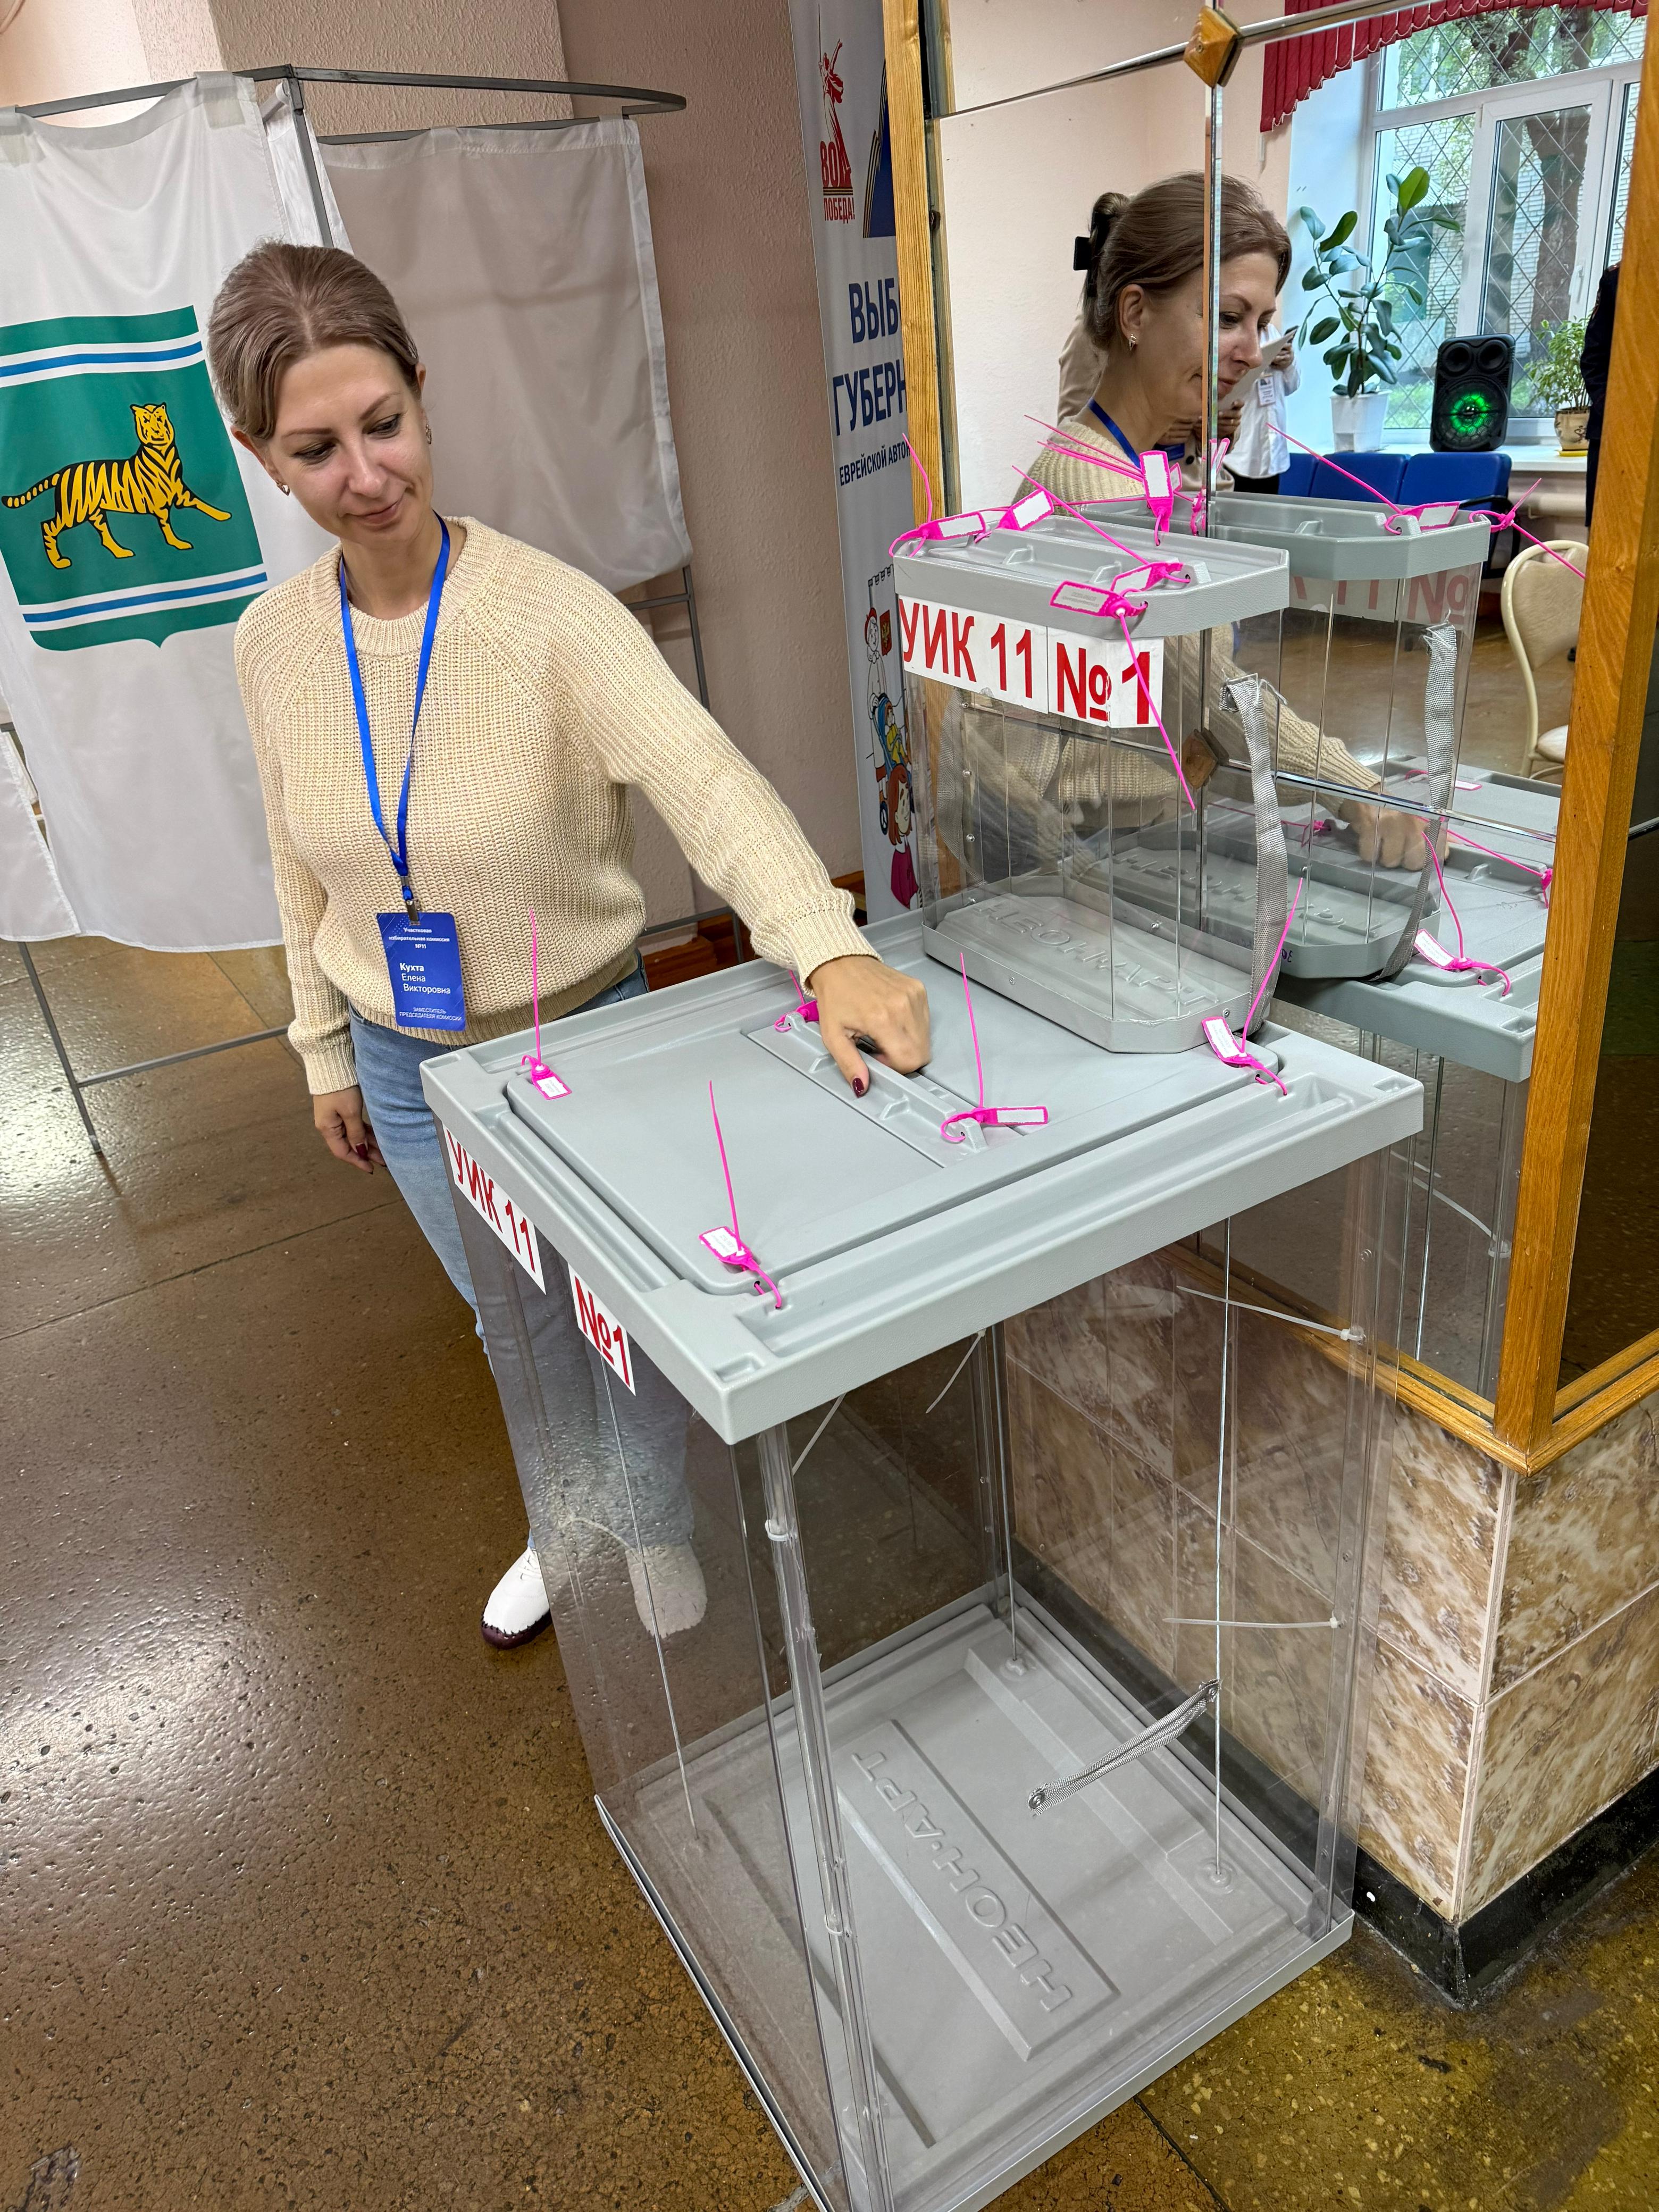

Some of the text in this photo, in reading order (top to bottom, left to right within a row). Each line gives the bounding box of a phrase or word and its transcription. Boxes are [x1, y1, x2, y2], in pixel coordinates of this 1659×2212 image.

[819, 141, 839, 188] 80
[824, 197, 855, 224] ПОБЕДА!
[849, 278, 898, 343] ВЫБ
[839, 446, 887, 486] ЕВРЕЙСКОЙ
[899, 599, 977, 683] УИК
[991, 623, 1033, 699] 11
[399, 962, 424, 973] Кухта
[401, 973, 426, 982] Елена
[403, 983, 451, 994] Викторовна
[447, 1129, 631, 1387] УИК 11 №1
